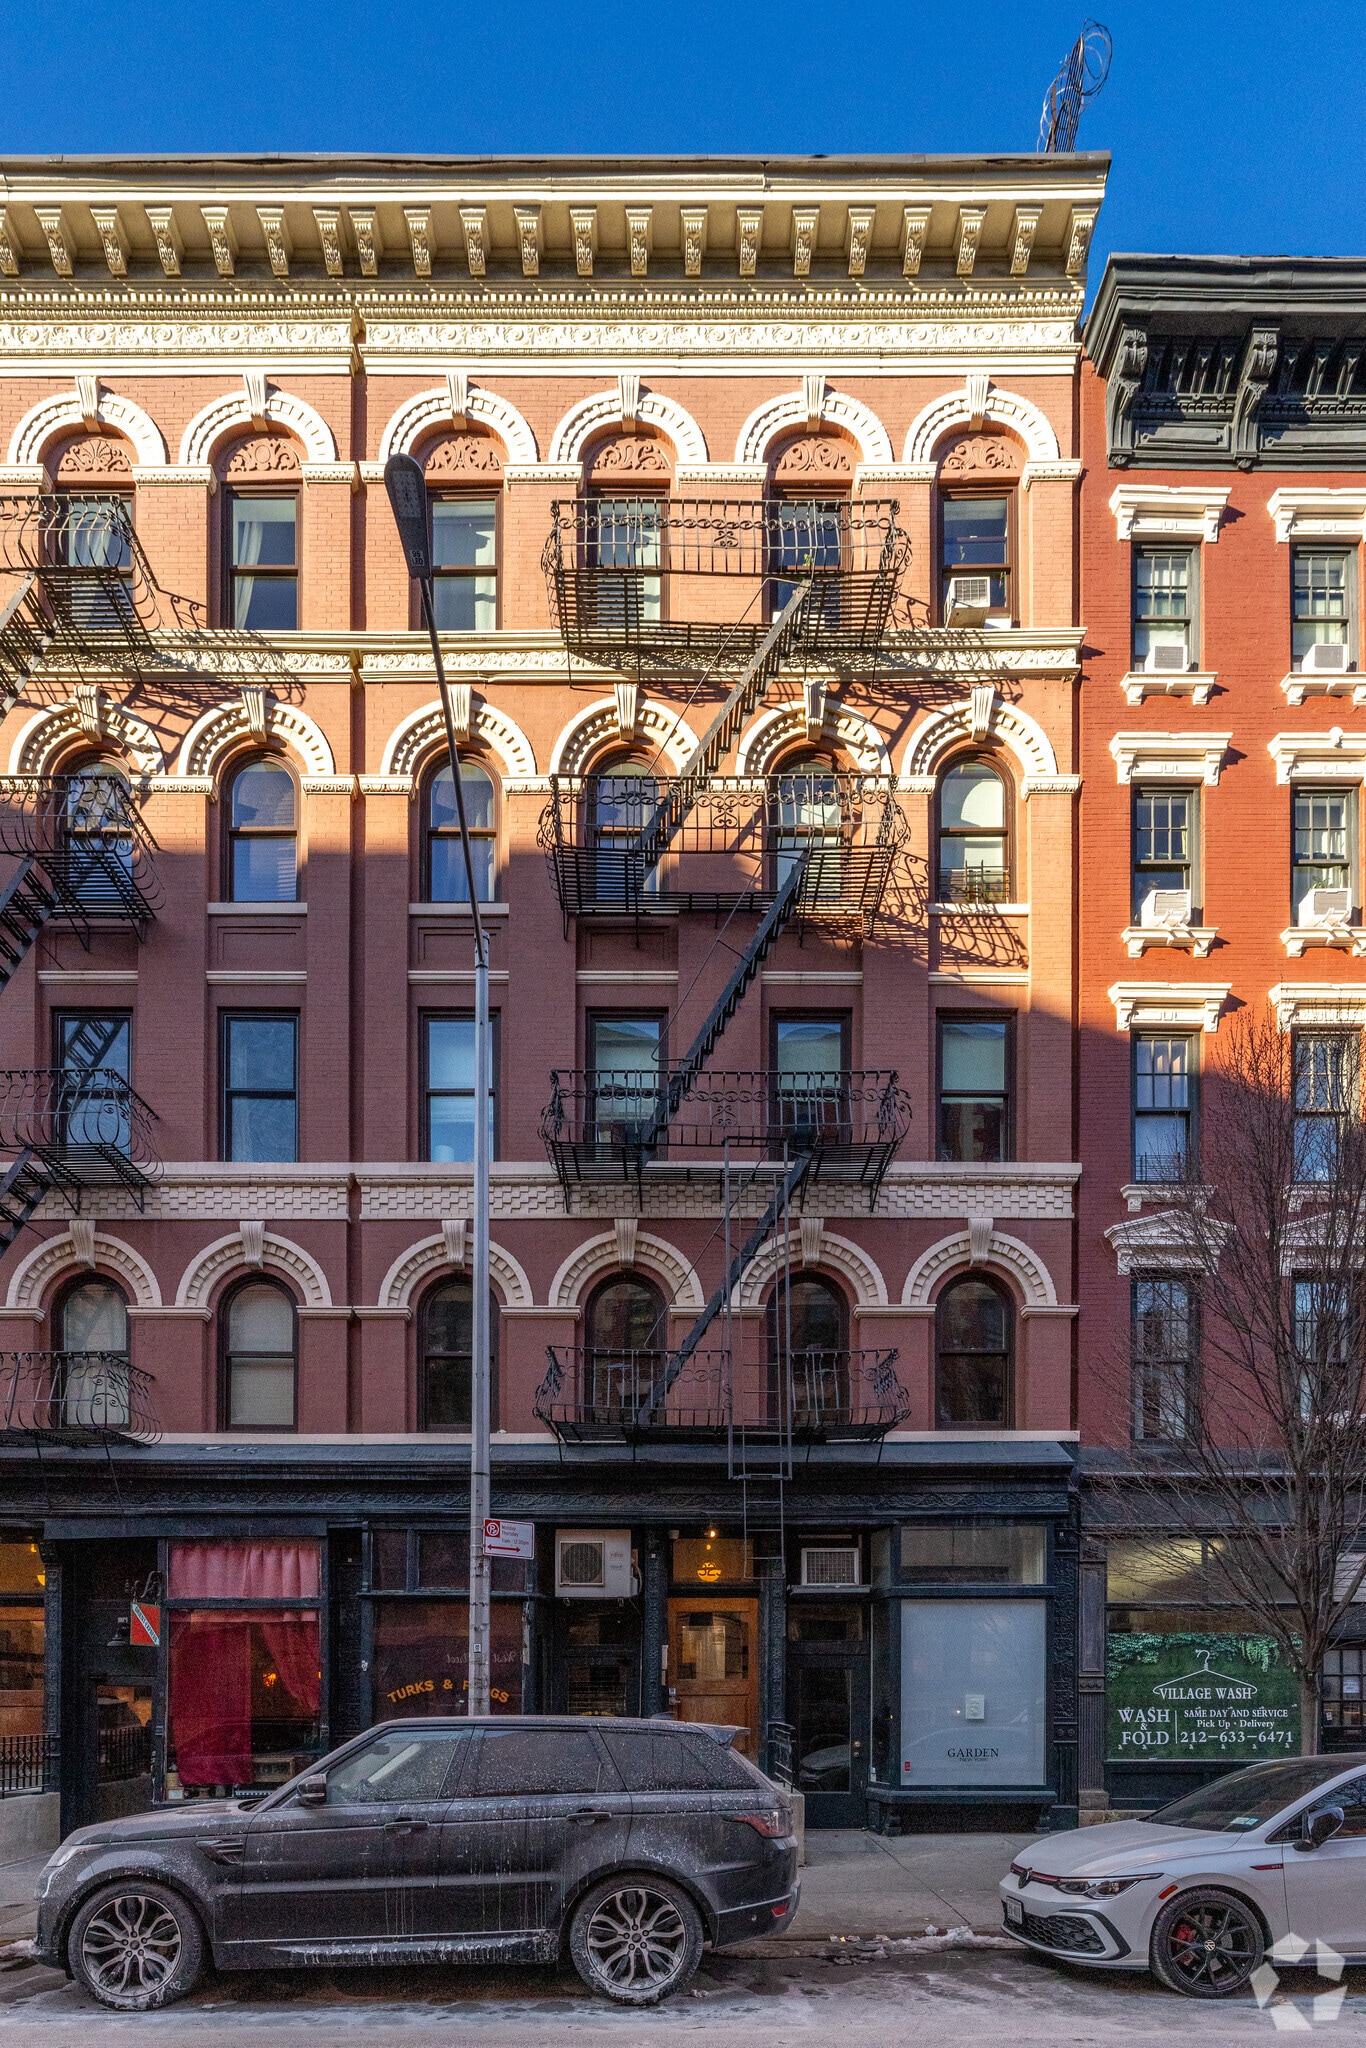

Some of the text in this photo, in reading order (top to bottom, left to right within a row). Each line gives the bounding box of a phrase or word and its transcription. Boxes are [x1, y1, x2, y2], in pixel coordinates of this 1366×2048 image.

[411, 557, 424, 565] LED
[387, 1680, 435, 1703] TURKS
[442, 1679, 454, 1690] &
[1159, 1687, 1252, 1700] VILLAGE WASH
[1117, 1708, 1171, 1723] WASH
[1184, 1709, 1289, 1718] SAME DAY AND SERVICE
[1140, 1722, 1148, 1731] &
[1196, 1719, 1275, 1730] Pick Up Delivery
[1121, 1731, 1170, 1745] FOLD
[1180, 1731, 1293, 1743] 212-633-6471
[947, 1747, 999, 1757] GARDEN
